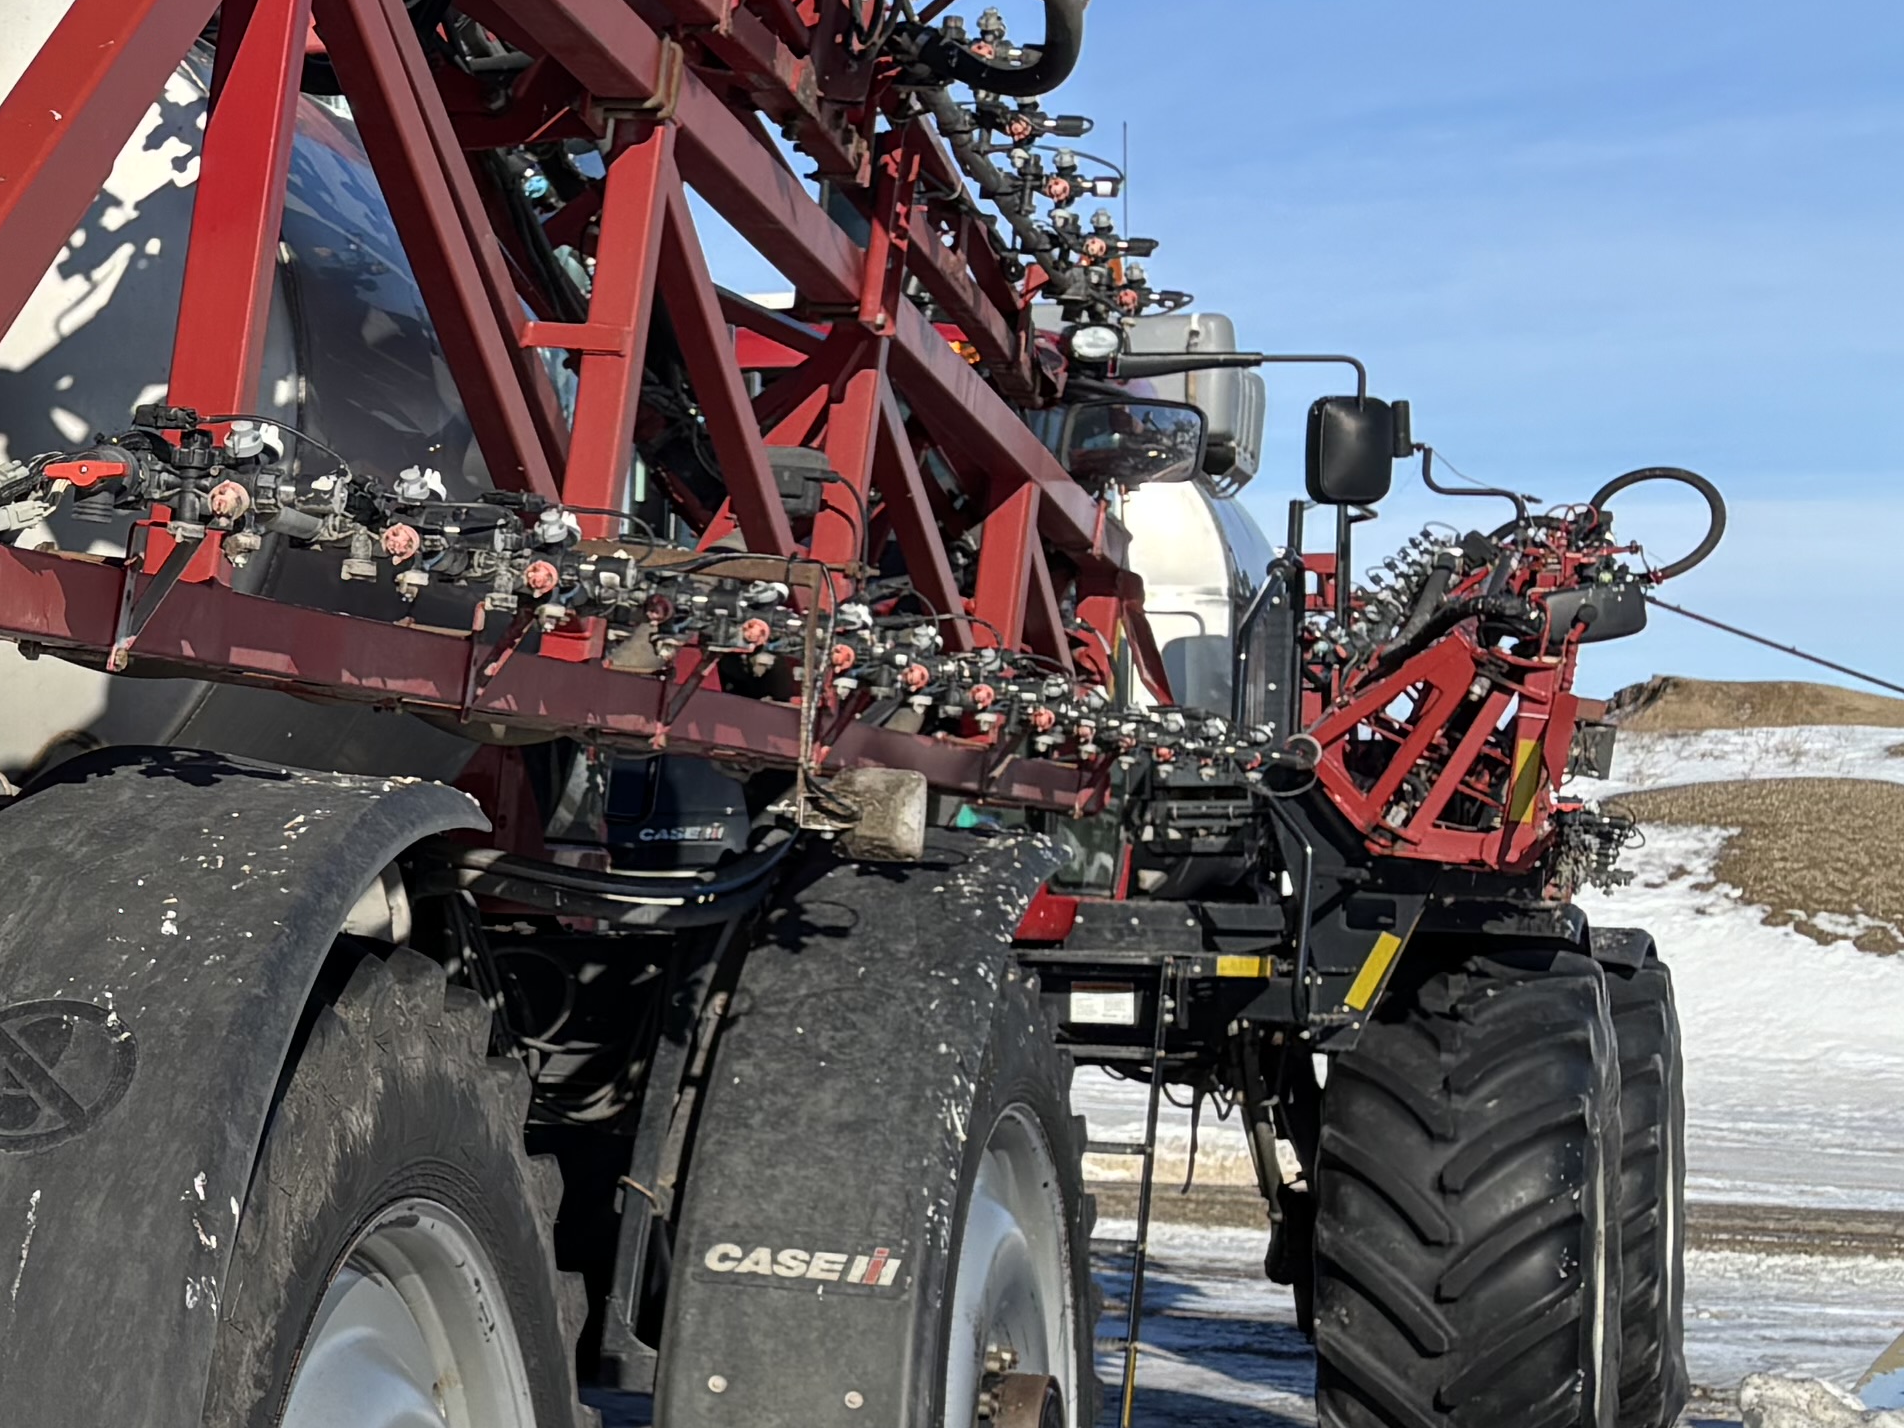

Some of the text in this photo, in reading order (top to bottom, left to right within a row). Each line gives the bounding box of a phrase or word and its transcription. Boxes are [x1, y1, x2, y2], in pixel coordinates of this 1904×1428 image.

[638, 826, 702, 842] CASE
[703, 1242, 902, 1287] CASE IH
